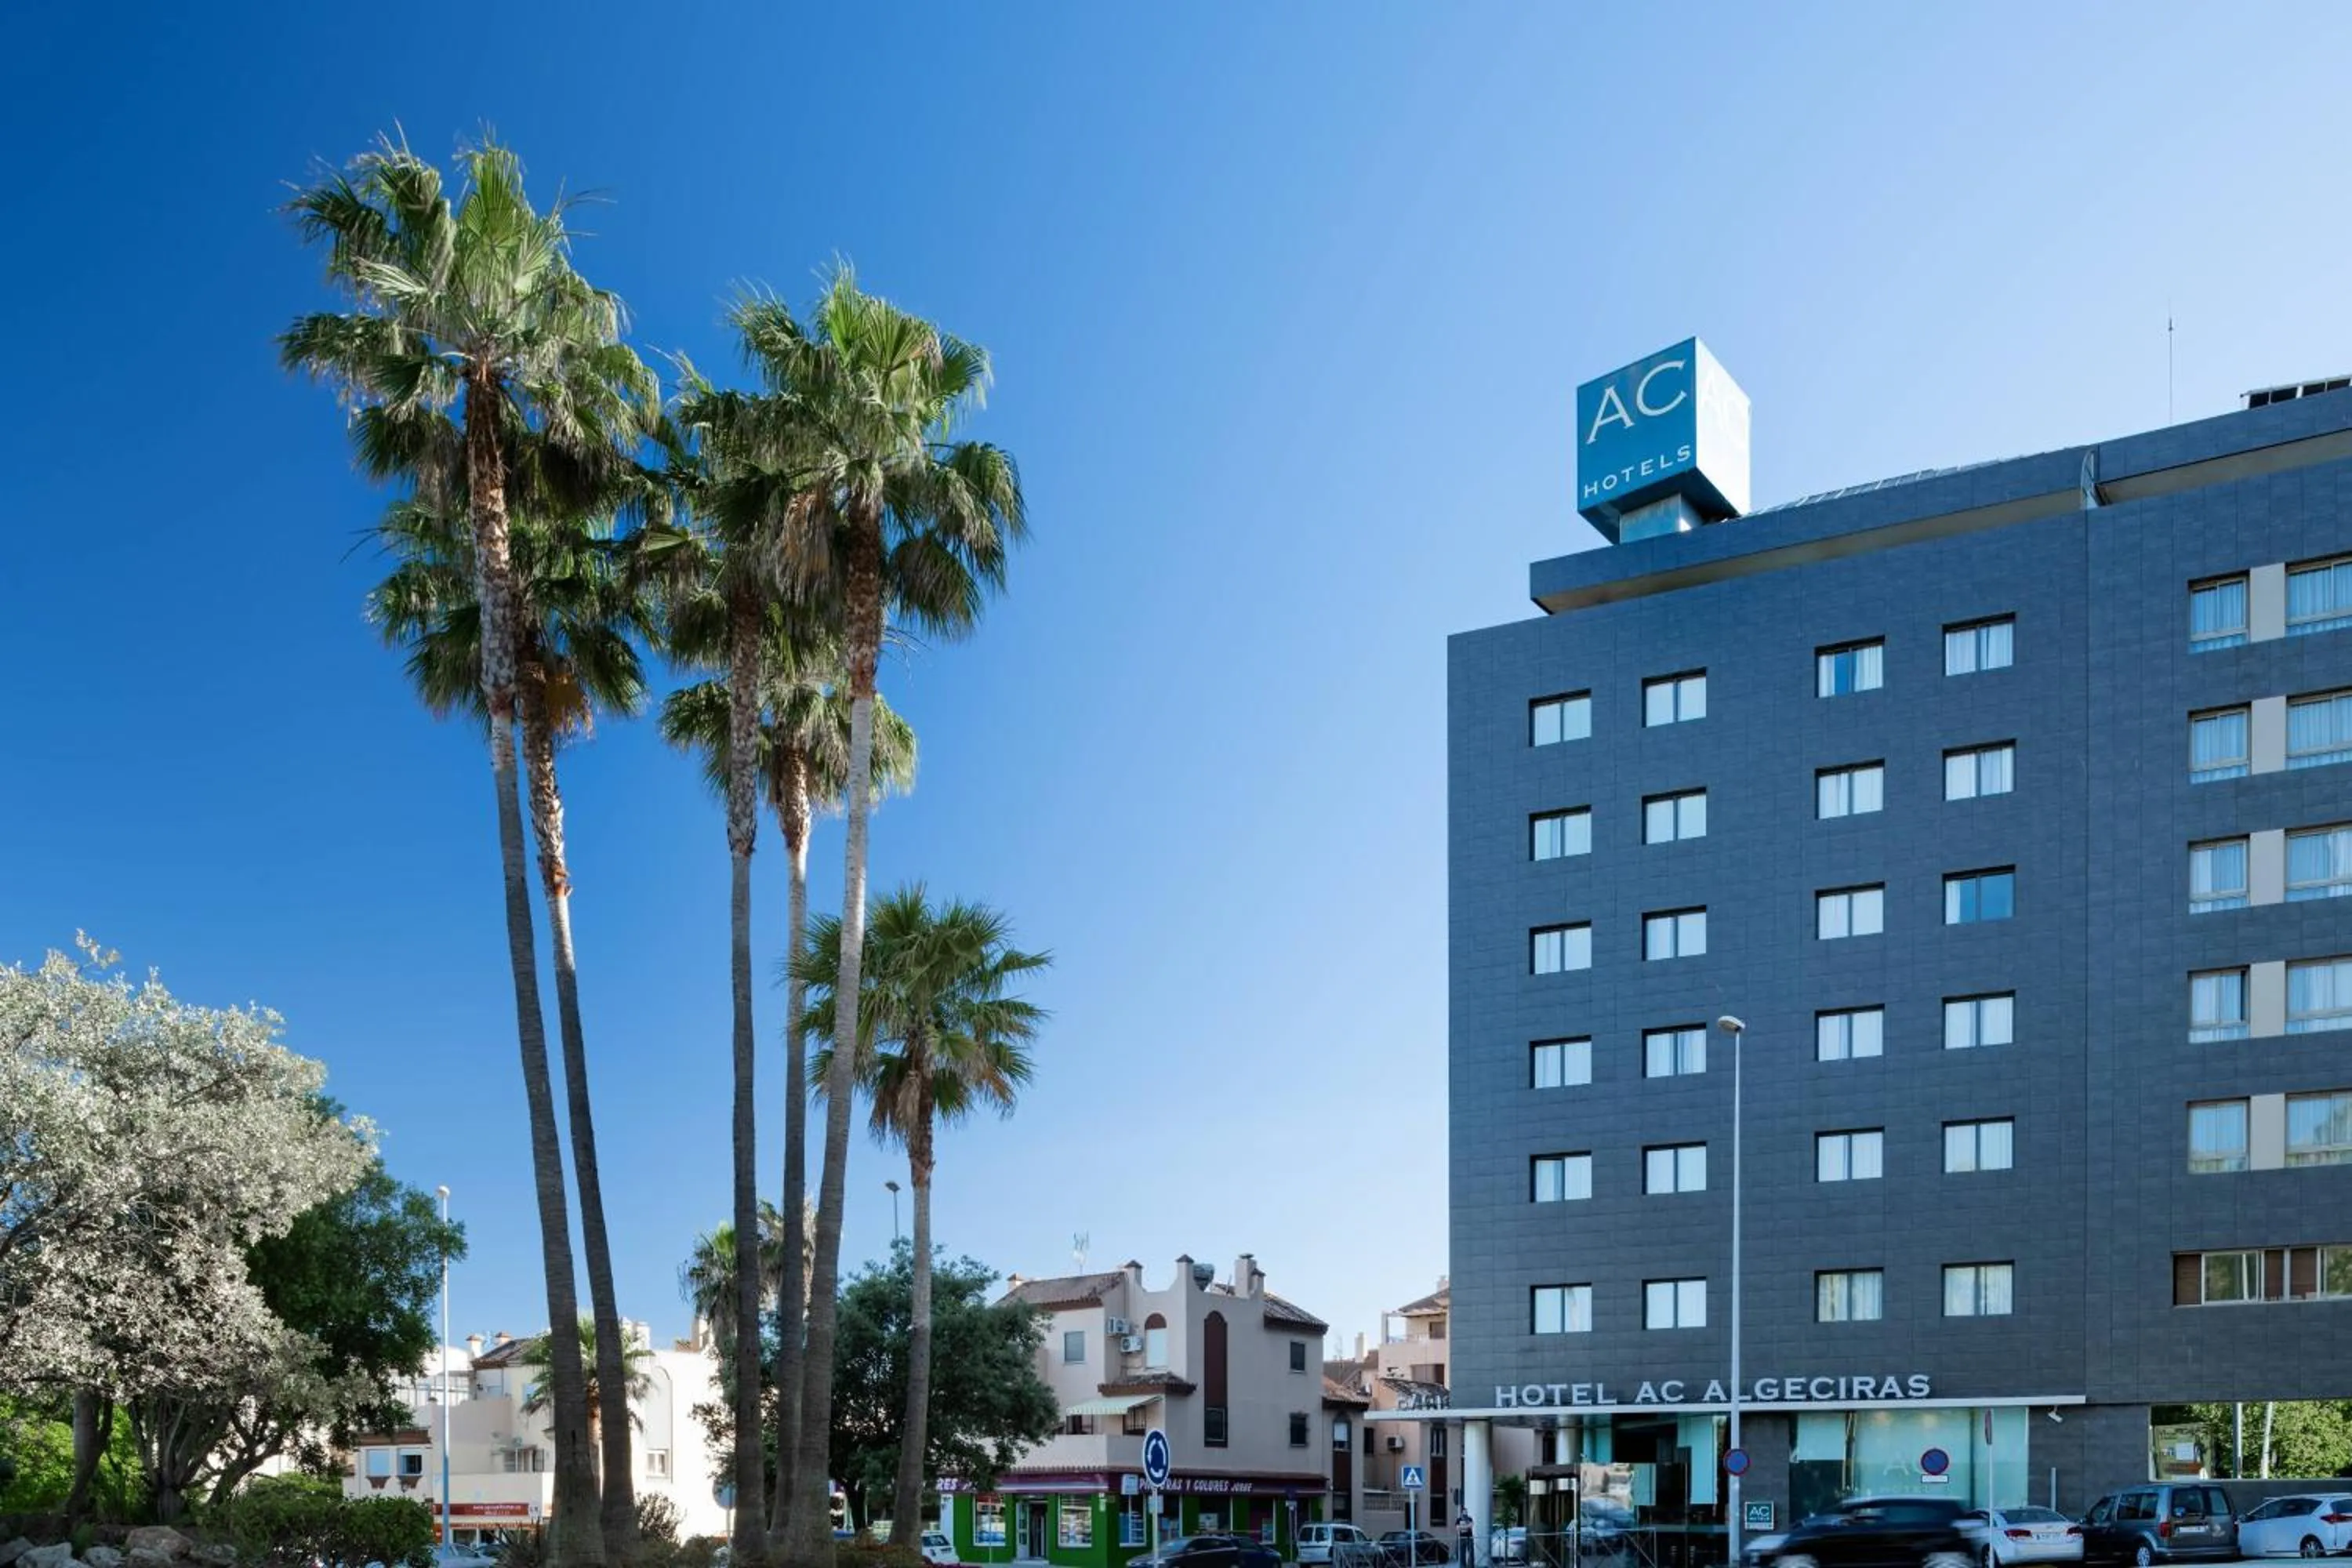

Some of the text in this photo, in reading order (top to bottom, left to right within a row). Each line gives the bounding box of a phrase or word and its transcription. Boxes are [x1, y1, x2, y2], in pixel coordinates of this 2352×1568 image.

[1586, 360, 1686, 445] AC
[1584, 445, 1691, 499] HOTELS
[1495, 1382, 1617, 1407] HOTEL
[1635, 1380, 1685, 1403] AC
[1749, 1505, 1769, 1517] AC
